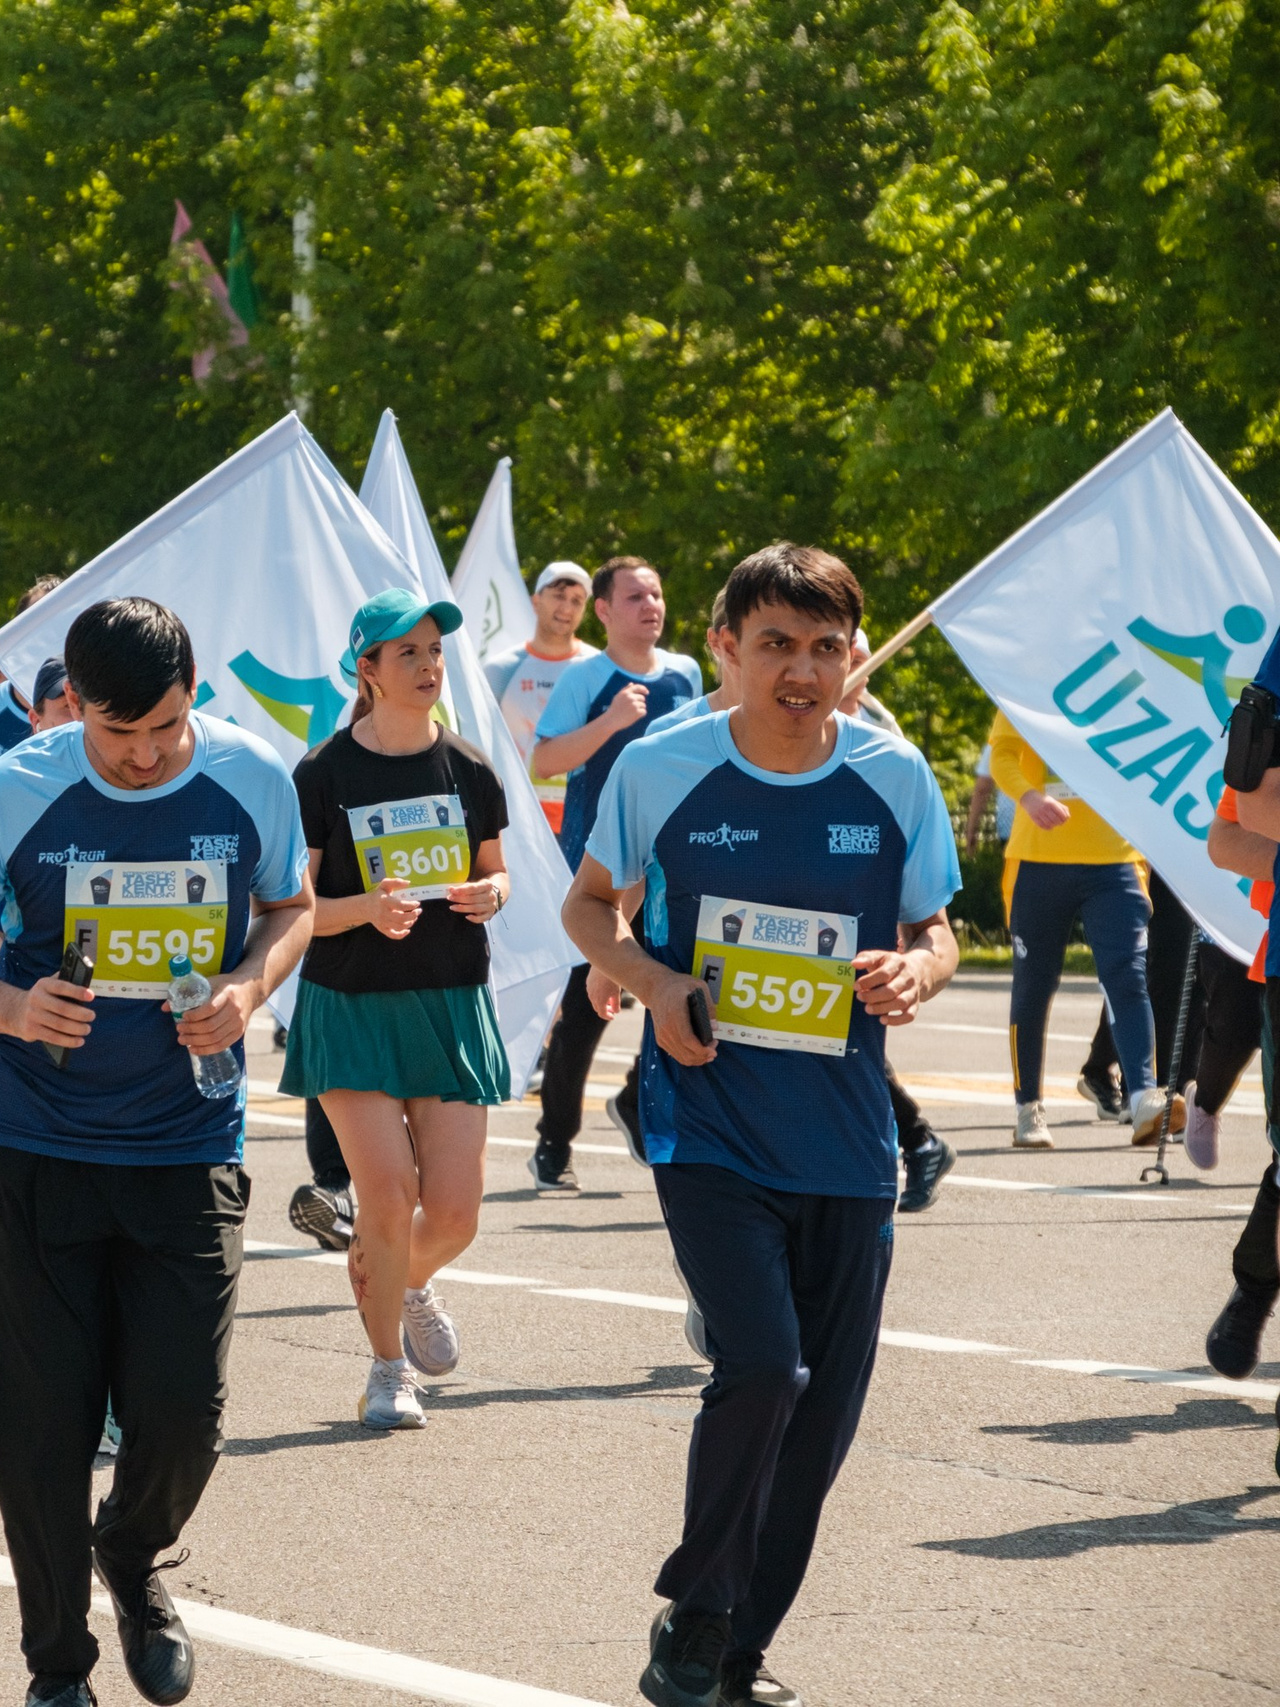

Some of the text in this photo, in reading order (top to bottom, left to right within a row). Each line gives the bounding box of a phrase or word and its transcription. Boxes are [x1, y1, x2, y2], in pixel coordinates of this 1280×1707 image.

[1053, 640, 1232, 842] UZAS
[389, 805, 424, 819] TASH
[455, 830, 466, 839] 5K
[689, 829, 759, 843] PRO RUN
[828, 828, 873, 841] TASH
[190, 838, 232, 850] TASH
[829, 838, 870, 850] KENT
[38, 850, 106, 864] PRO RUN
[390, 844, 463, 878] 3601
[369, 856, 380, 875] F
[122, 872, 169, 886] TASH
[122, 884, 166, 896] KENT
[209, 909, 224, 919] 5K
[755, 913, 802, 934] TASH
[78, 929, 92, 951] F
[752, 925, 798, 943] KENT
[107, 928, 215, 966] 5595
[837, 965, 852, 977] 5K
[730, 971, 843, 1020] 5597
